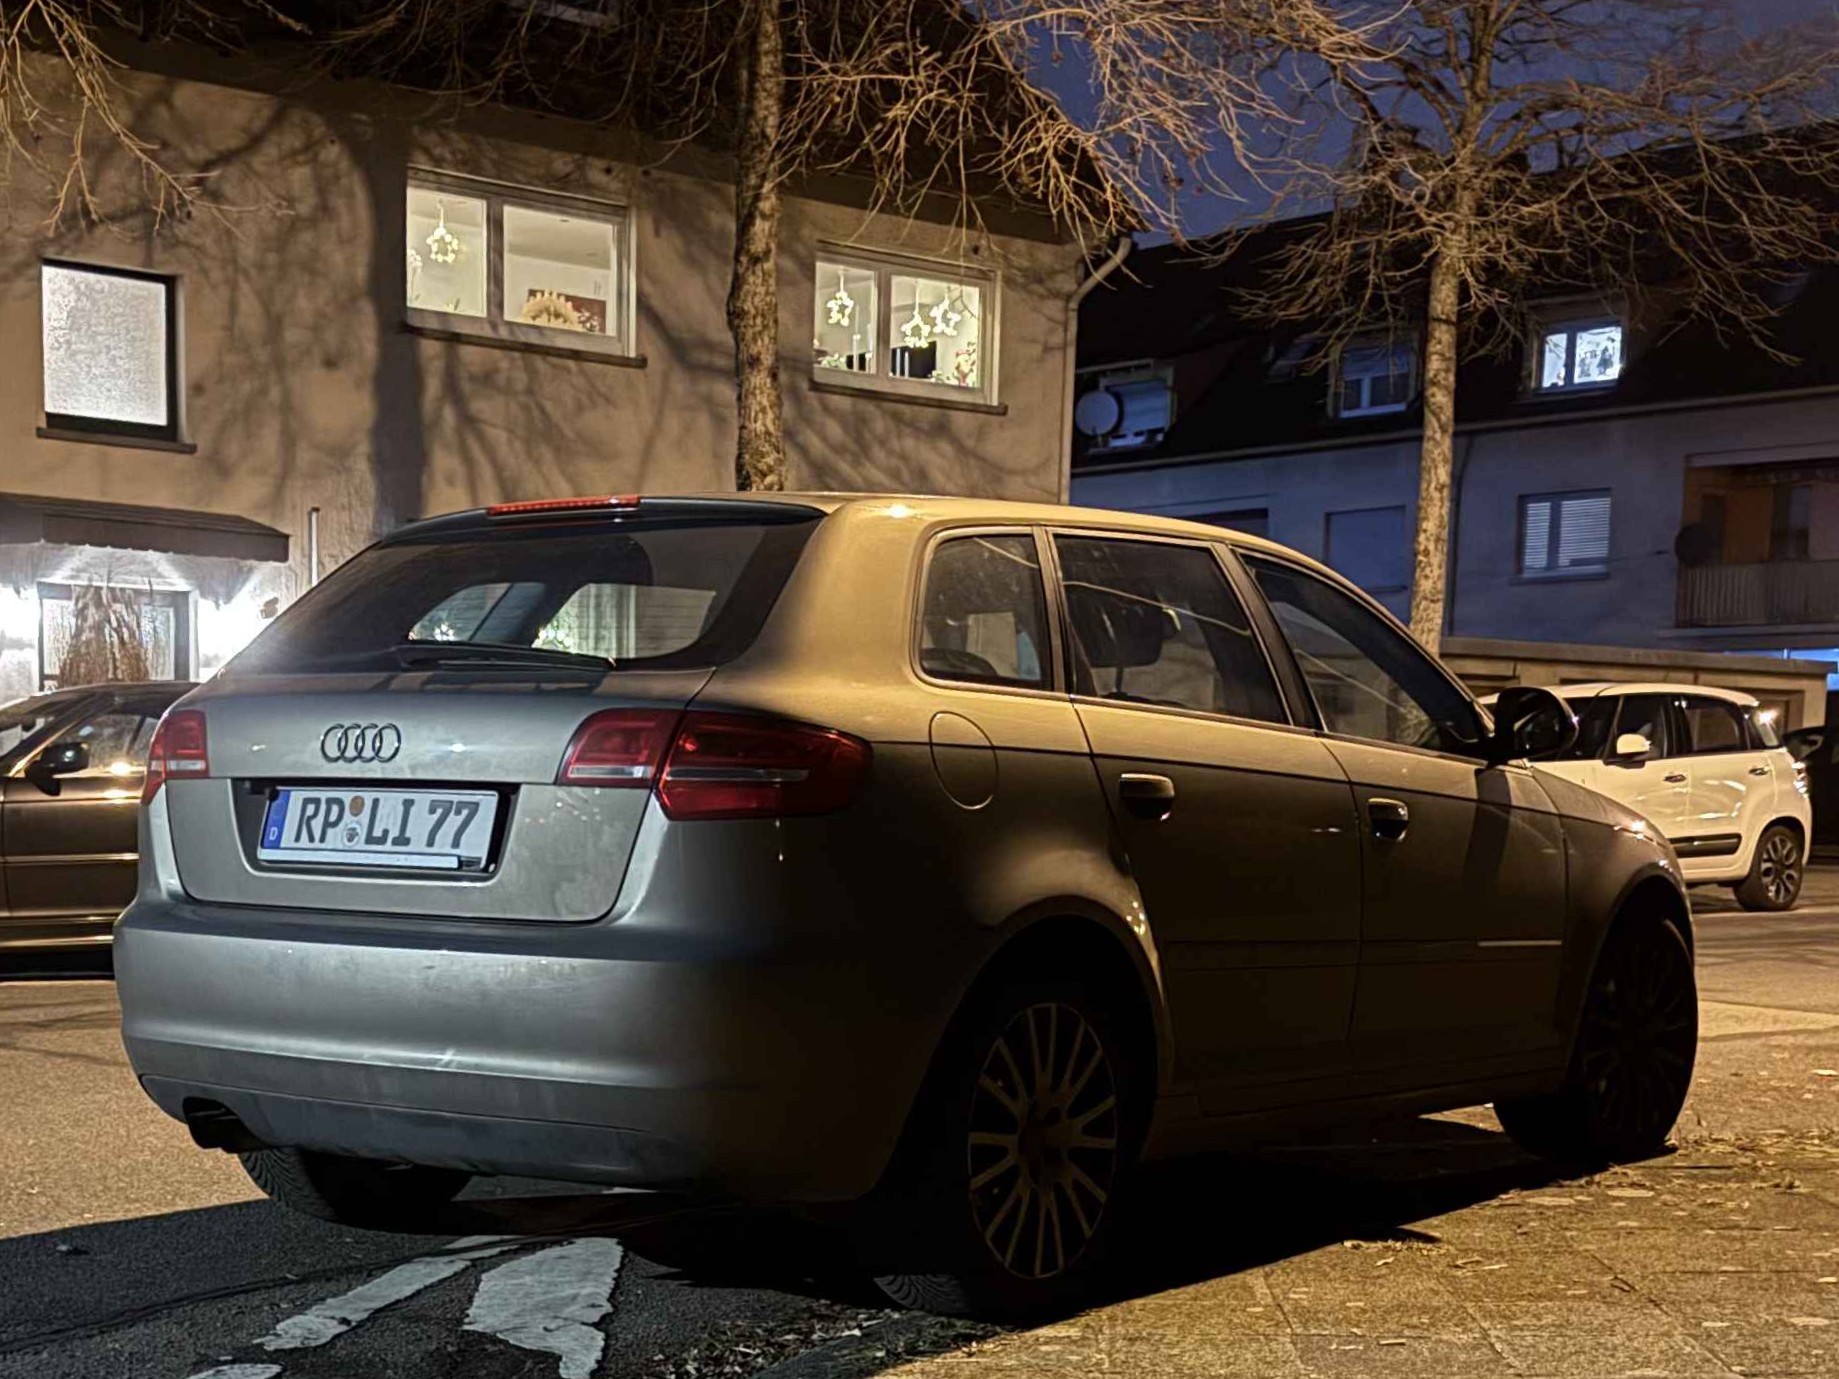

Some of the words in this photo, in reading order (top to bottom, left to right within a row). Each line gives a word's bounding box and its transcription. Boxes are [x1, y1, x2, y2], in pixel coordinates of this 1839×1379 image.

[268, 826, 279, 841] D
[293, 797, 346, 844] RP
[364, 797, 415, 847] LI
[425, 799, 480, 850] 77
